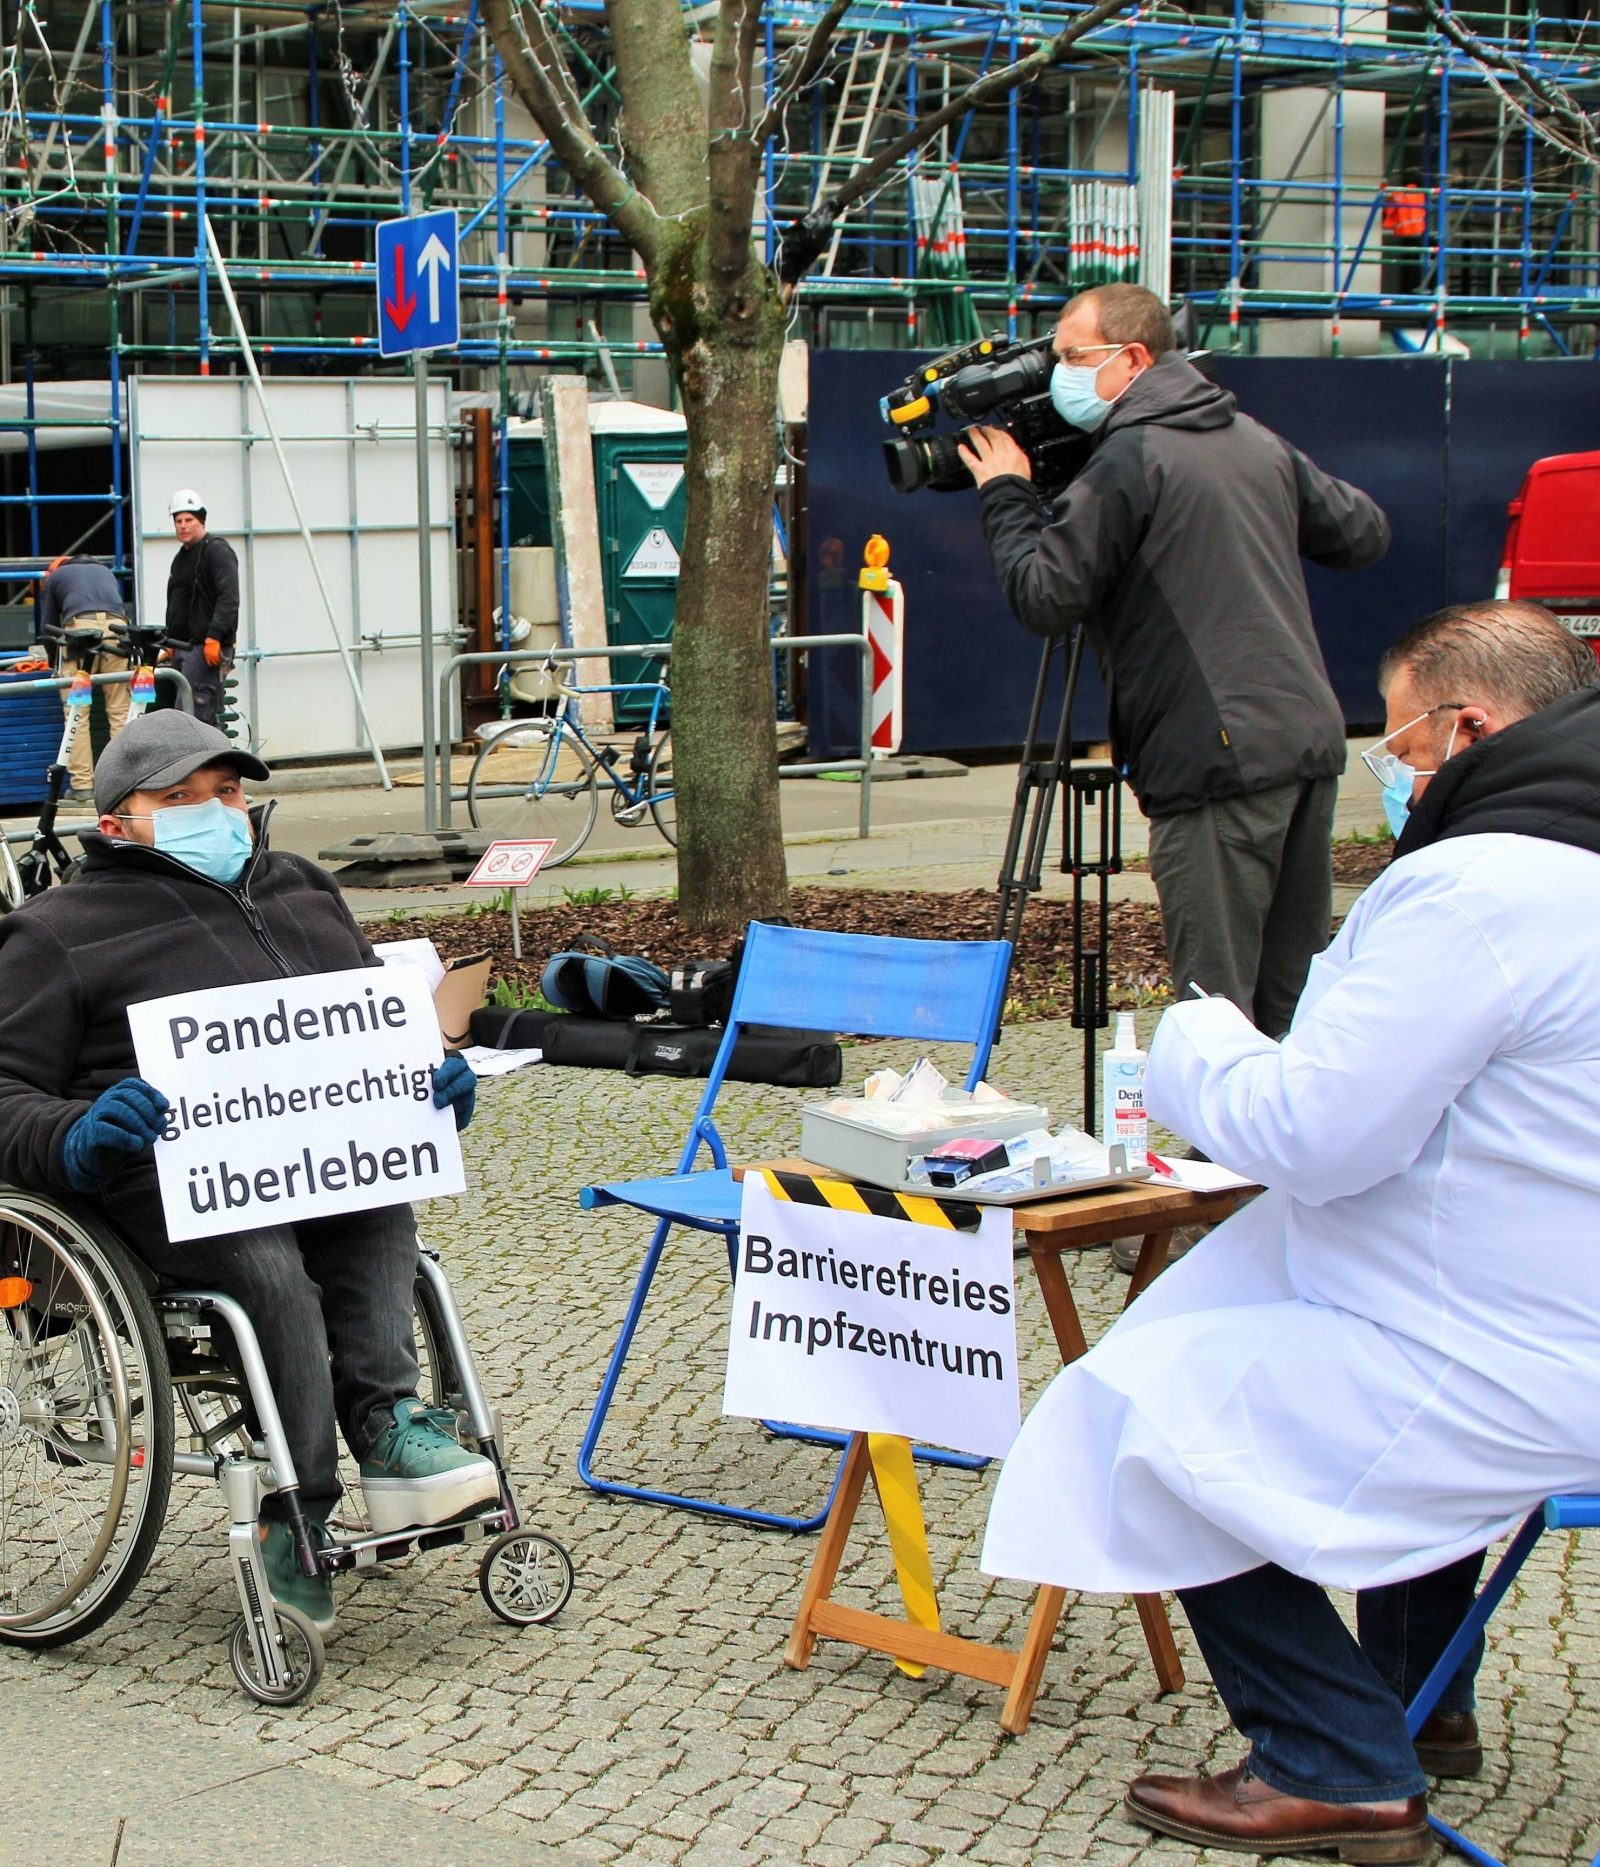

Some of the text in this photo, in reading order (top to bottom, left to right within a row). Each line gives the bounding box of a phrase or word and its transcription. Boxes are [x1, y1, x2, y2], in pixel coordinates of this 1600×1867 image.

[1573, 617, 1600, 632] 449
[169, 988, 407, 1059] Pandemie
[160, 1063, 437, 1141] gleichberechtigt
[188, 1140, 439, 1214] überleben
[744, 1235, 1011, 1315] Barrierefreies
[749, 1301, 1004, 1381] Impfzentrum
